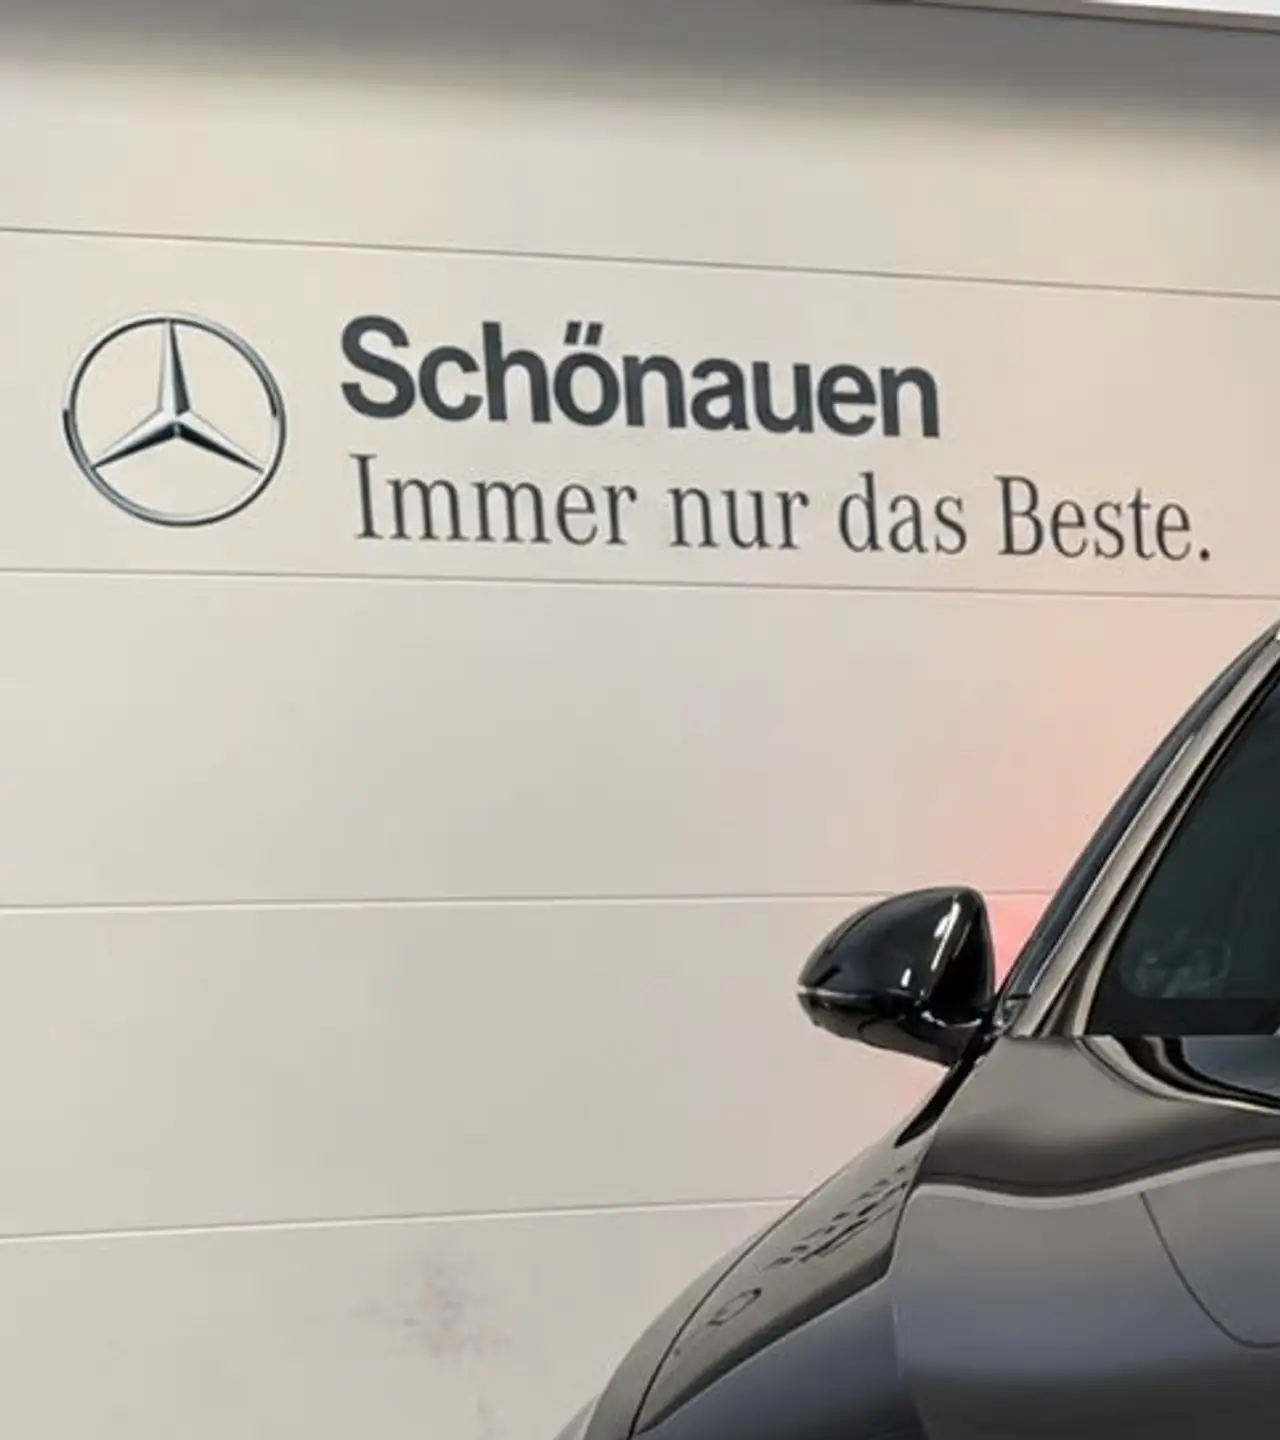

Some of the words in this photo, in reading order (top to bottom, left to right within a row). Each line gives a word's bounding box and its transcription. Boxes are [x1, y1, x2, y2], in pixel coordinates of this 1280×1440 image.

[341, 315, 941, 438] Schönauen
[349, 453, 638, 546] Immer
[668, 487, 810, 550] nur
[838, 470, 968, 556] das
[996, 475, 1212, 563] Beste.
